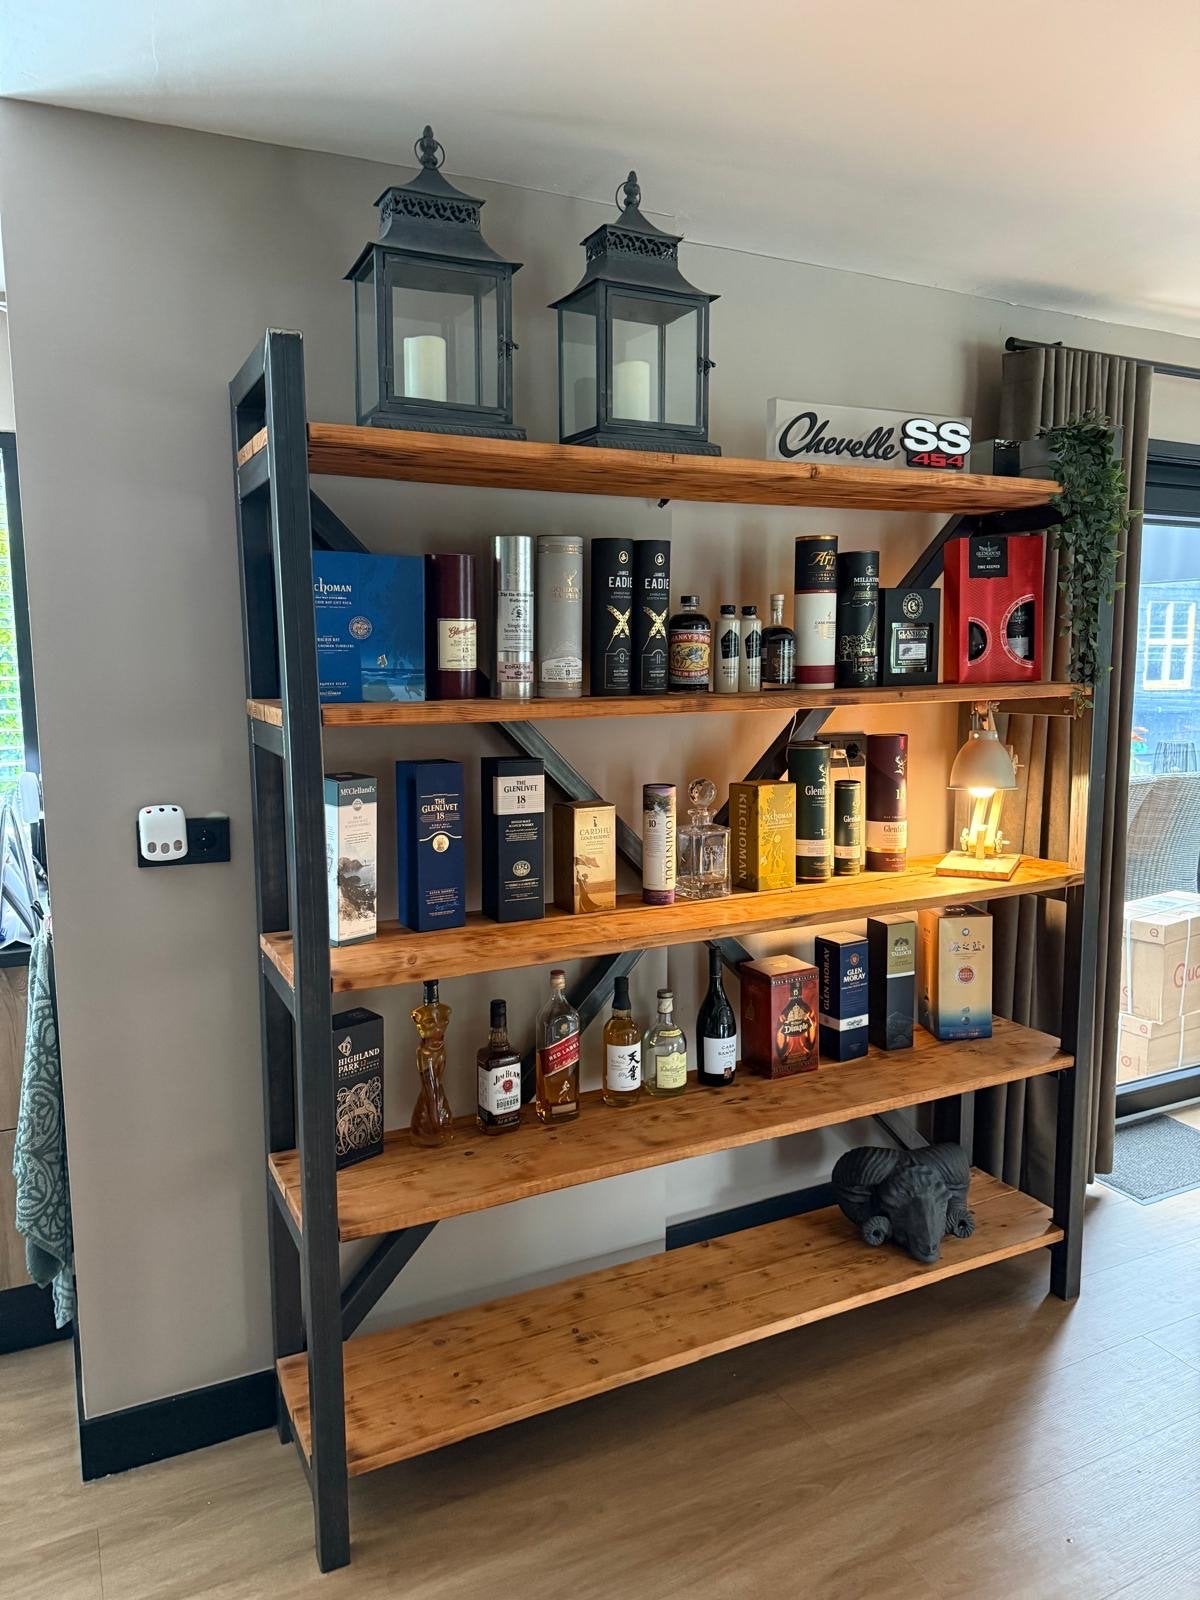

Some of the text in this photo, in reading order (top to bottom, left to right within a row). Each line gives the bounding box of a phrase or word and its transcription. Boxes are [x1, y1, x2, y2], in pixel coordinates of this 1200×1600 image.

[778, 411, 972, 460] Chevelle SS
[911, 452, 964, 467] 454
[619, 652, 625, 664] 9
[503, 784, 539, 793] GLENLIVET
[516, 795, 527, 804] 18
[421, 803, 458, 813] GLENLIVET
[739, 793, 747, 880] KILCHOMAN
[665, 815, 674, 885] TOMINTOUL
[846, 967, 863, 976] GLEN
[843, 973, 867, 983] MORAY
[822, 985, 831, 1010] GLEN
[784, 1022, 809, 1034] Dimple
[338, 1048, 380, 1067] HIGHLAND
[548, 1042, 580, 1061] RED LABEL
[338, 1062, 359, 1074] PARK
